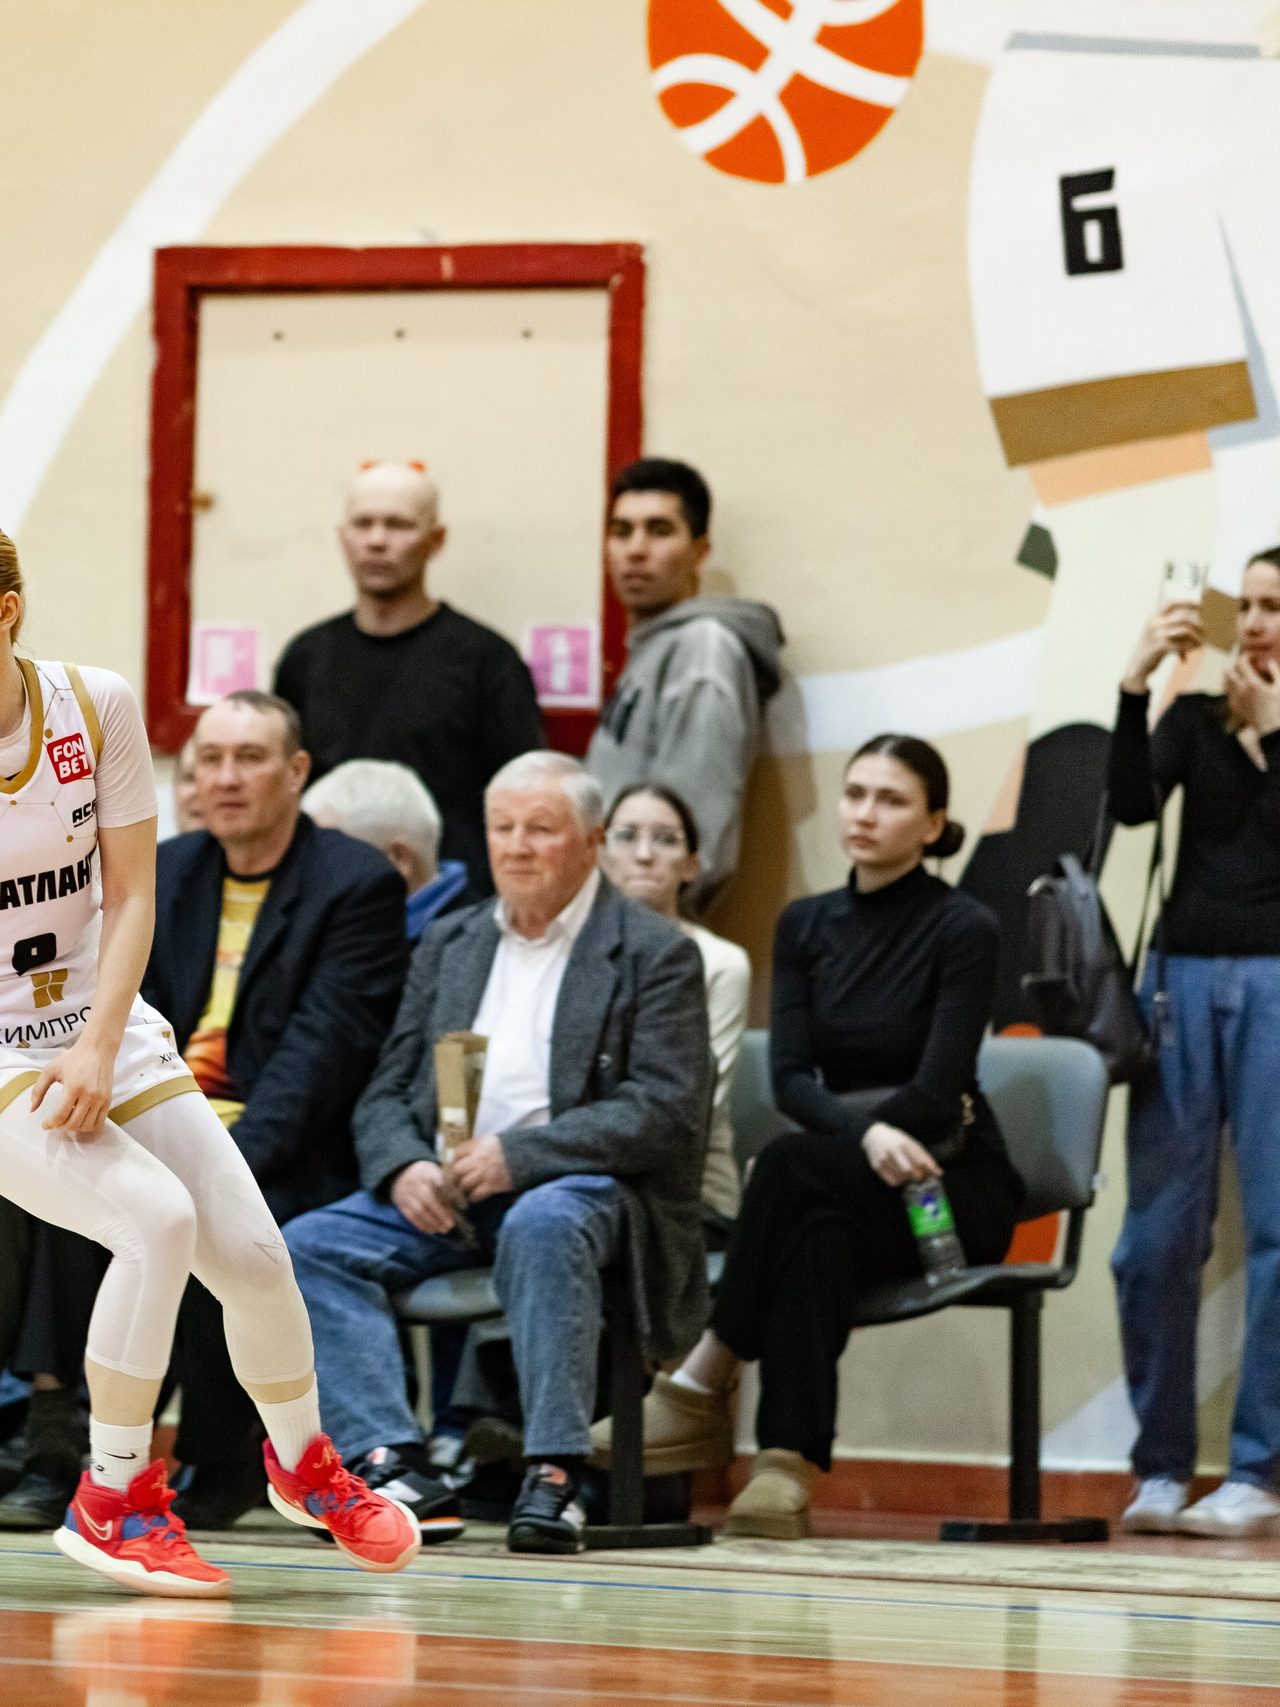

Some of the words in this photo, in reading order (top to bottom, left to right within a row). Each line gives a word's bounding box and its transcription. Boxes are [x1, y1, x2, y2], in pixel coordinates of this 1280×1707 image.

[1059, 165, 1125, 277] 6
[52, 737, 85, 763] FON
[58, 753, 90, 779] BET
